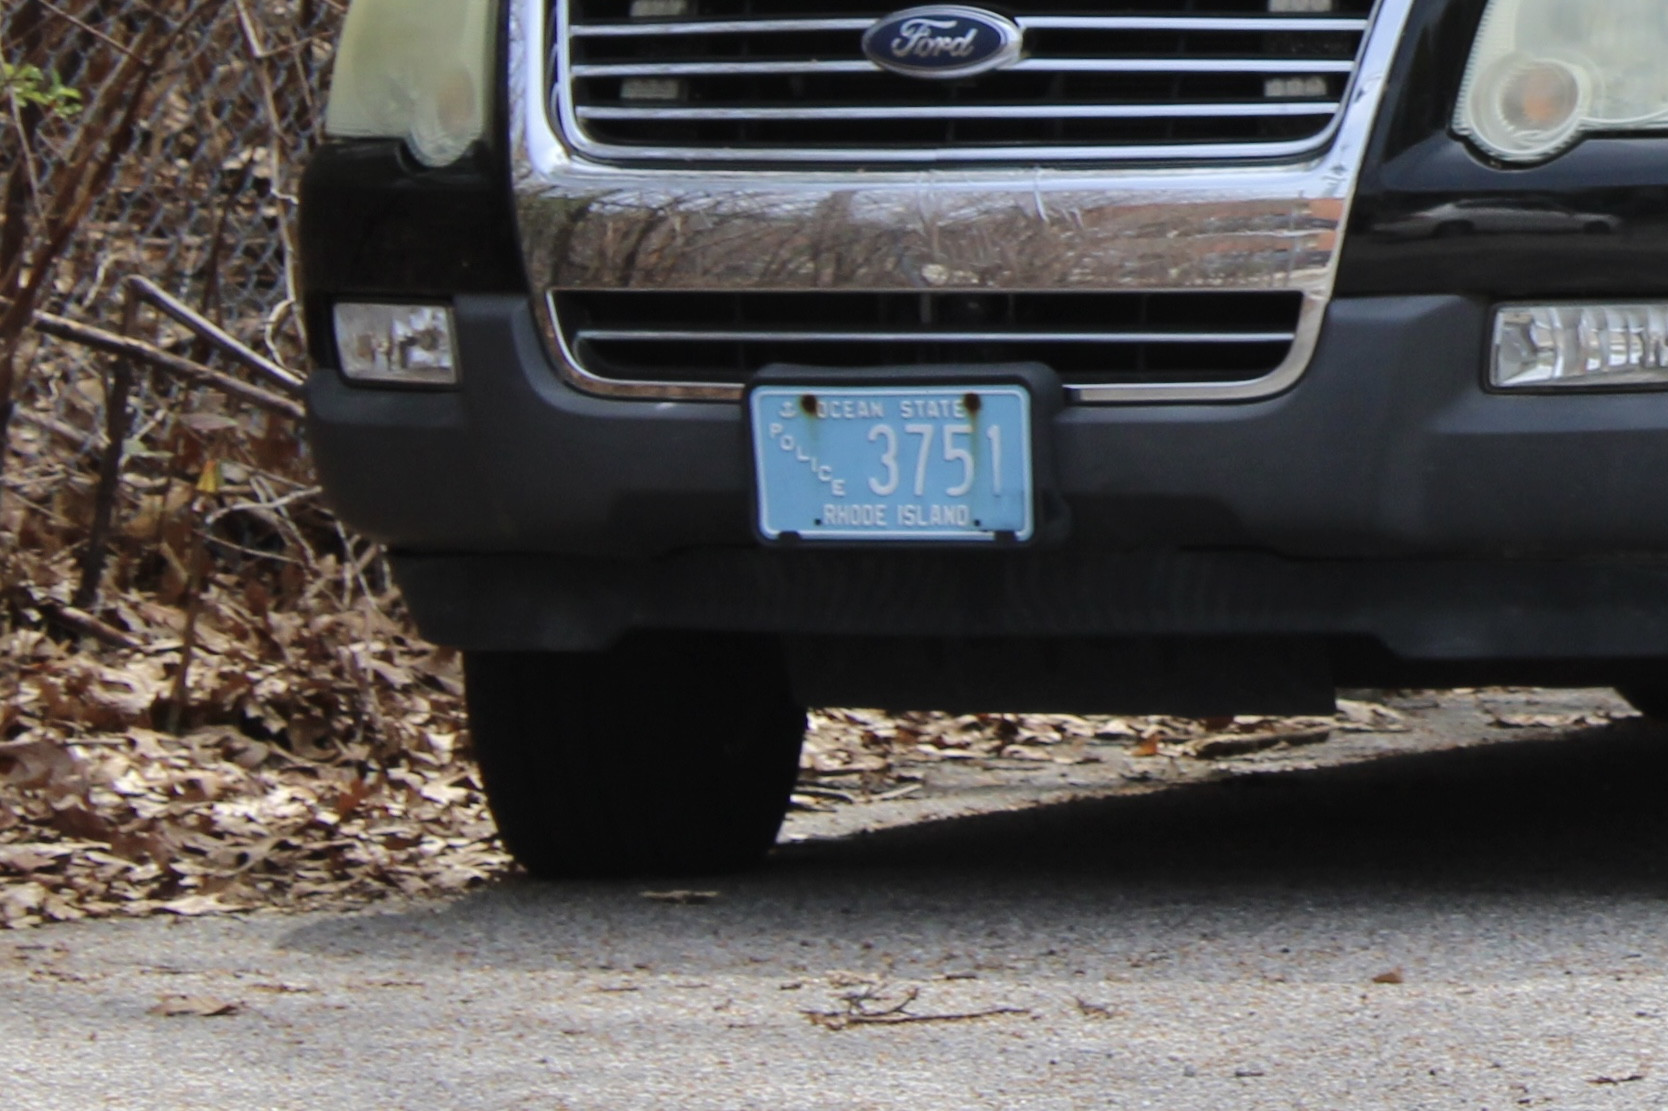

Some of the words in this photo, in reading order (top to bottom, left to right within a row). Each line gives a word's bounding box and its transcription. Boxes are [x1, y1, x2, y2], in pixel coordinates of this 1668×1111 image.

[891, 18, 978, 57] Ford
[816, 400, 884, 419] OCEAN
[901, 400, 966, 419] STATE
[769, 423, 846, 497] POLICE
[868, 424, 1003, 498] 3751
[823, 503, 888, 527] RHODE
[897, 504, 971, 527] ISLAND
